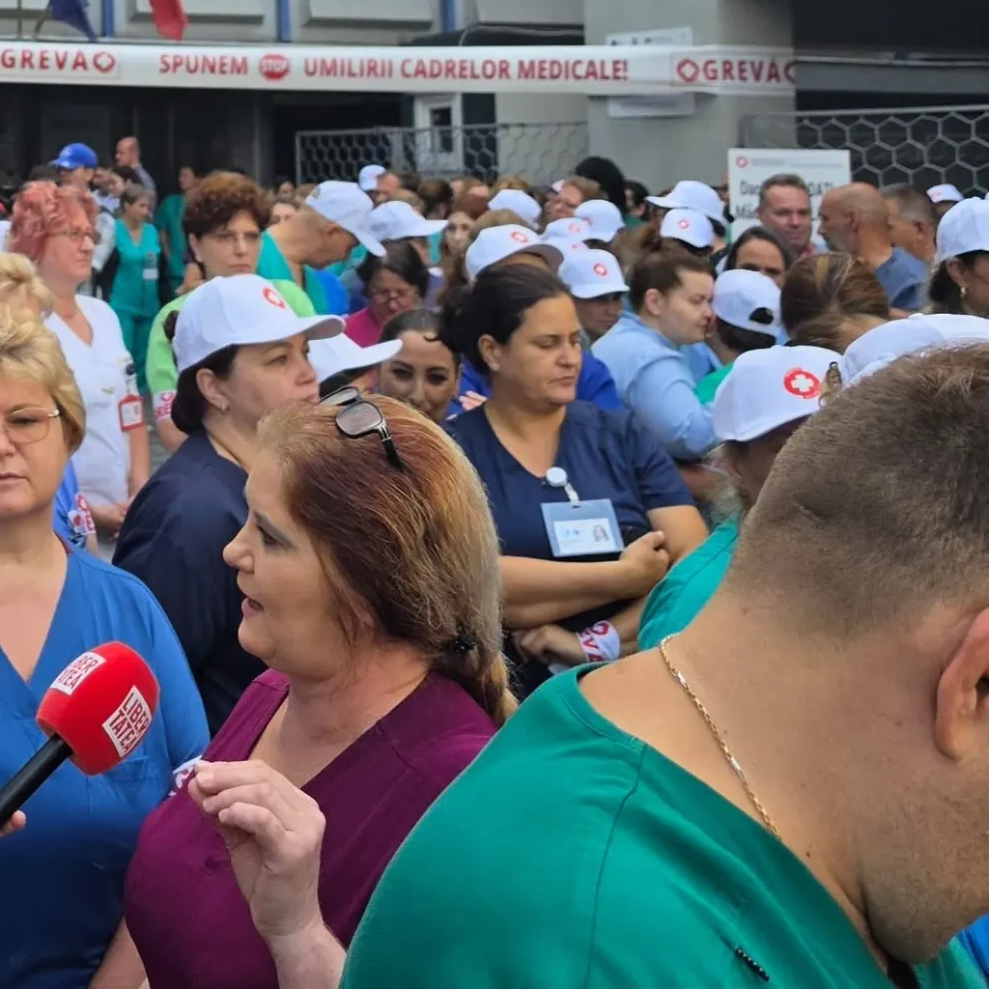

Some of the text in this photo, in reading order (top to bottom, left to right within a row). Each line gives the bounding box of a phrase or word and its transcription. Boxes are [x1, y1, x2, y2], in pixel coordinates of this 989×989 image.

[160, 54, 628, 82] SPUNEM STOP UMILIRII CADRELOR MEDICALE!
[109, 709, 138, 753] TATEA
[122, 692, 149, 738] LIBER
